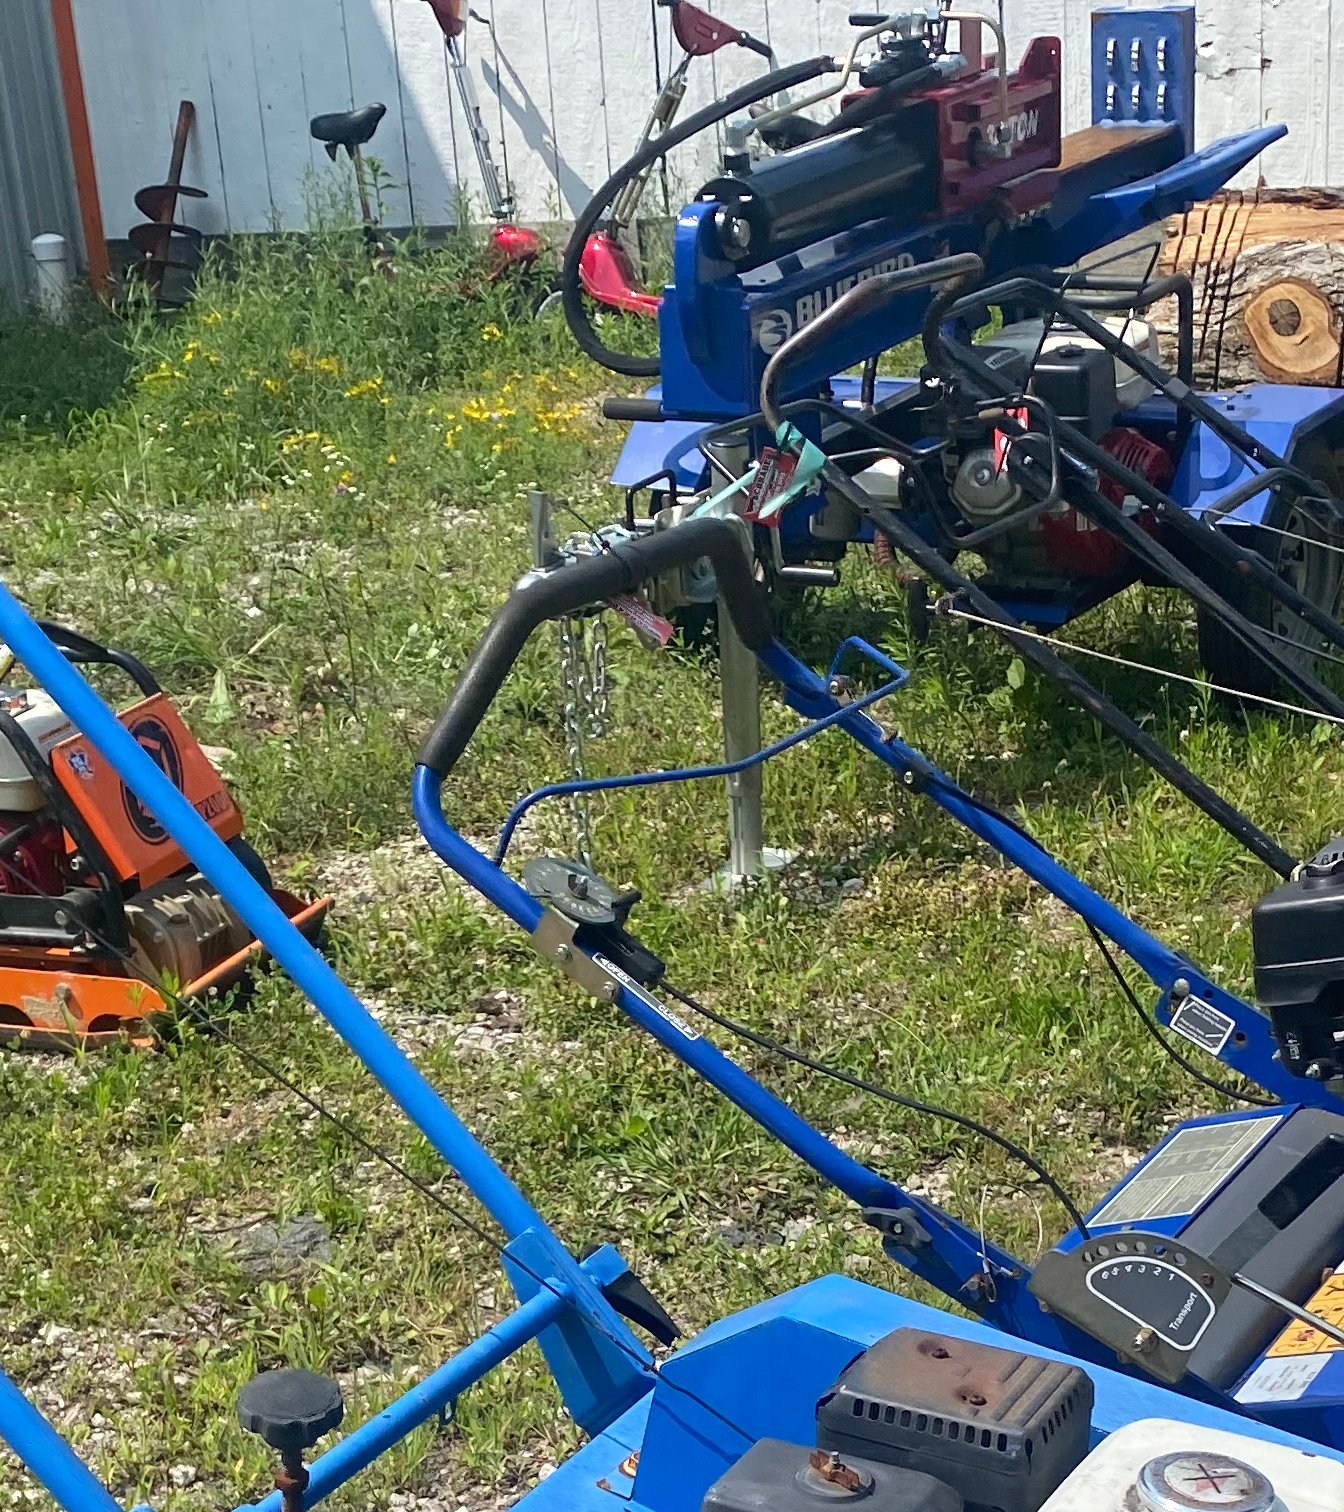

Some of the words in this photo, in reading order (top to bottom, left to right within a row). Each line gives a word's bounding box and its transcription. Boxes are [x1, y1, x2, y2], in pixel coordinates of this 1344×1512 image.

[608, 964, 631, 982] OPEN
[657, 1004, 687, 1031] CLOSE
[1124, 1264, 1133, 1273] 4
[1138, 1264, 1146, 1274] 3
[1153, 1265, 1162, 1277] 2
[1168, 1273, 1175, 1281] 1
[1169, 1292, 1198, 1331] Transport
